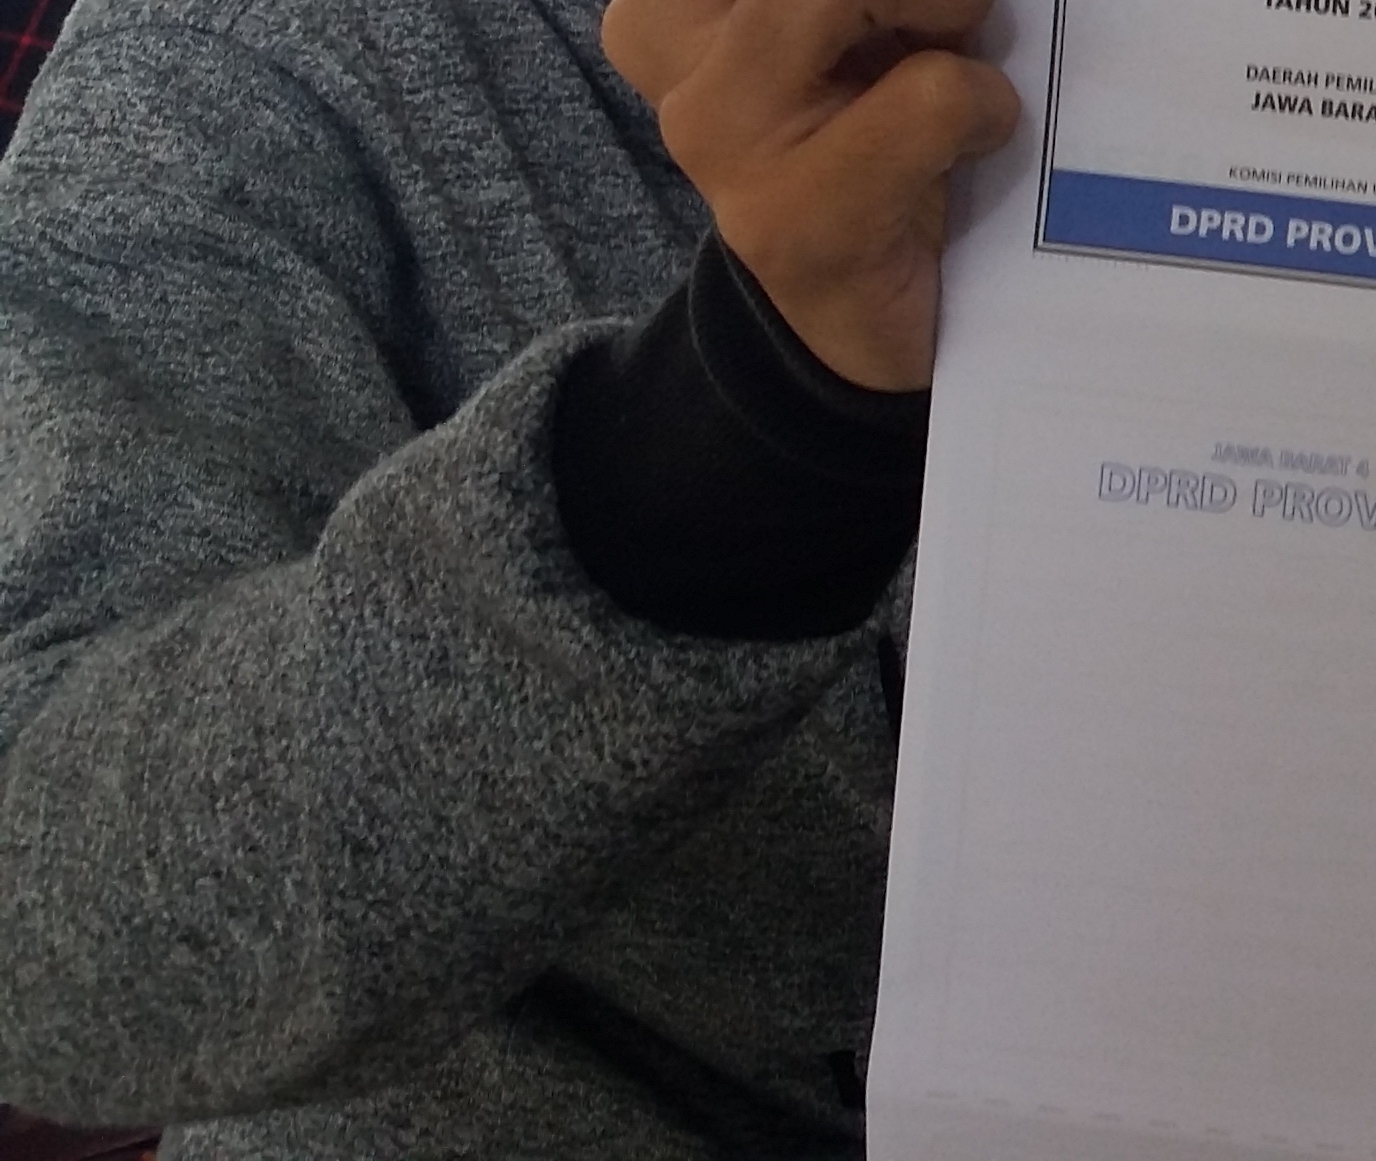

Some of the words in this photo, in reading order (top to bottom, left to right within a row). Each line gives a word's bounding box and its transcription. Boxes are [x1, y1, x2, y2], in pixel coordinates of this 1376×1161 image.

[1245, 63, 1320, 89] DAERAH
[1250, 91, 1314, 117] JAWA
[1228, 165, 1282, 185] KOMISI
[1169, 204, 1274, 245] DPRD
[1098, 461, 1237, 514] DPRD
